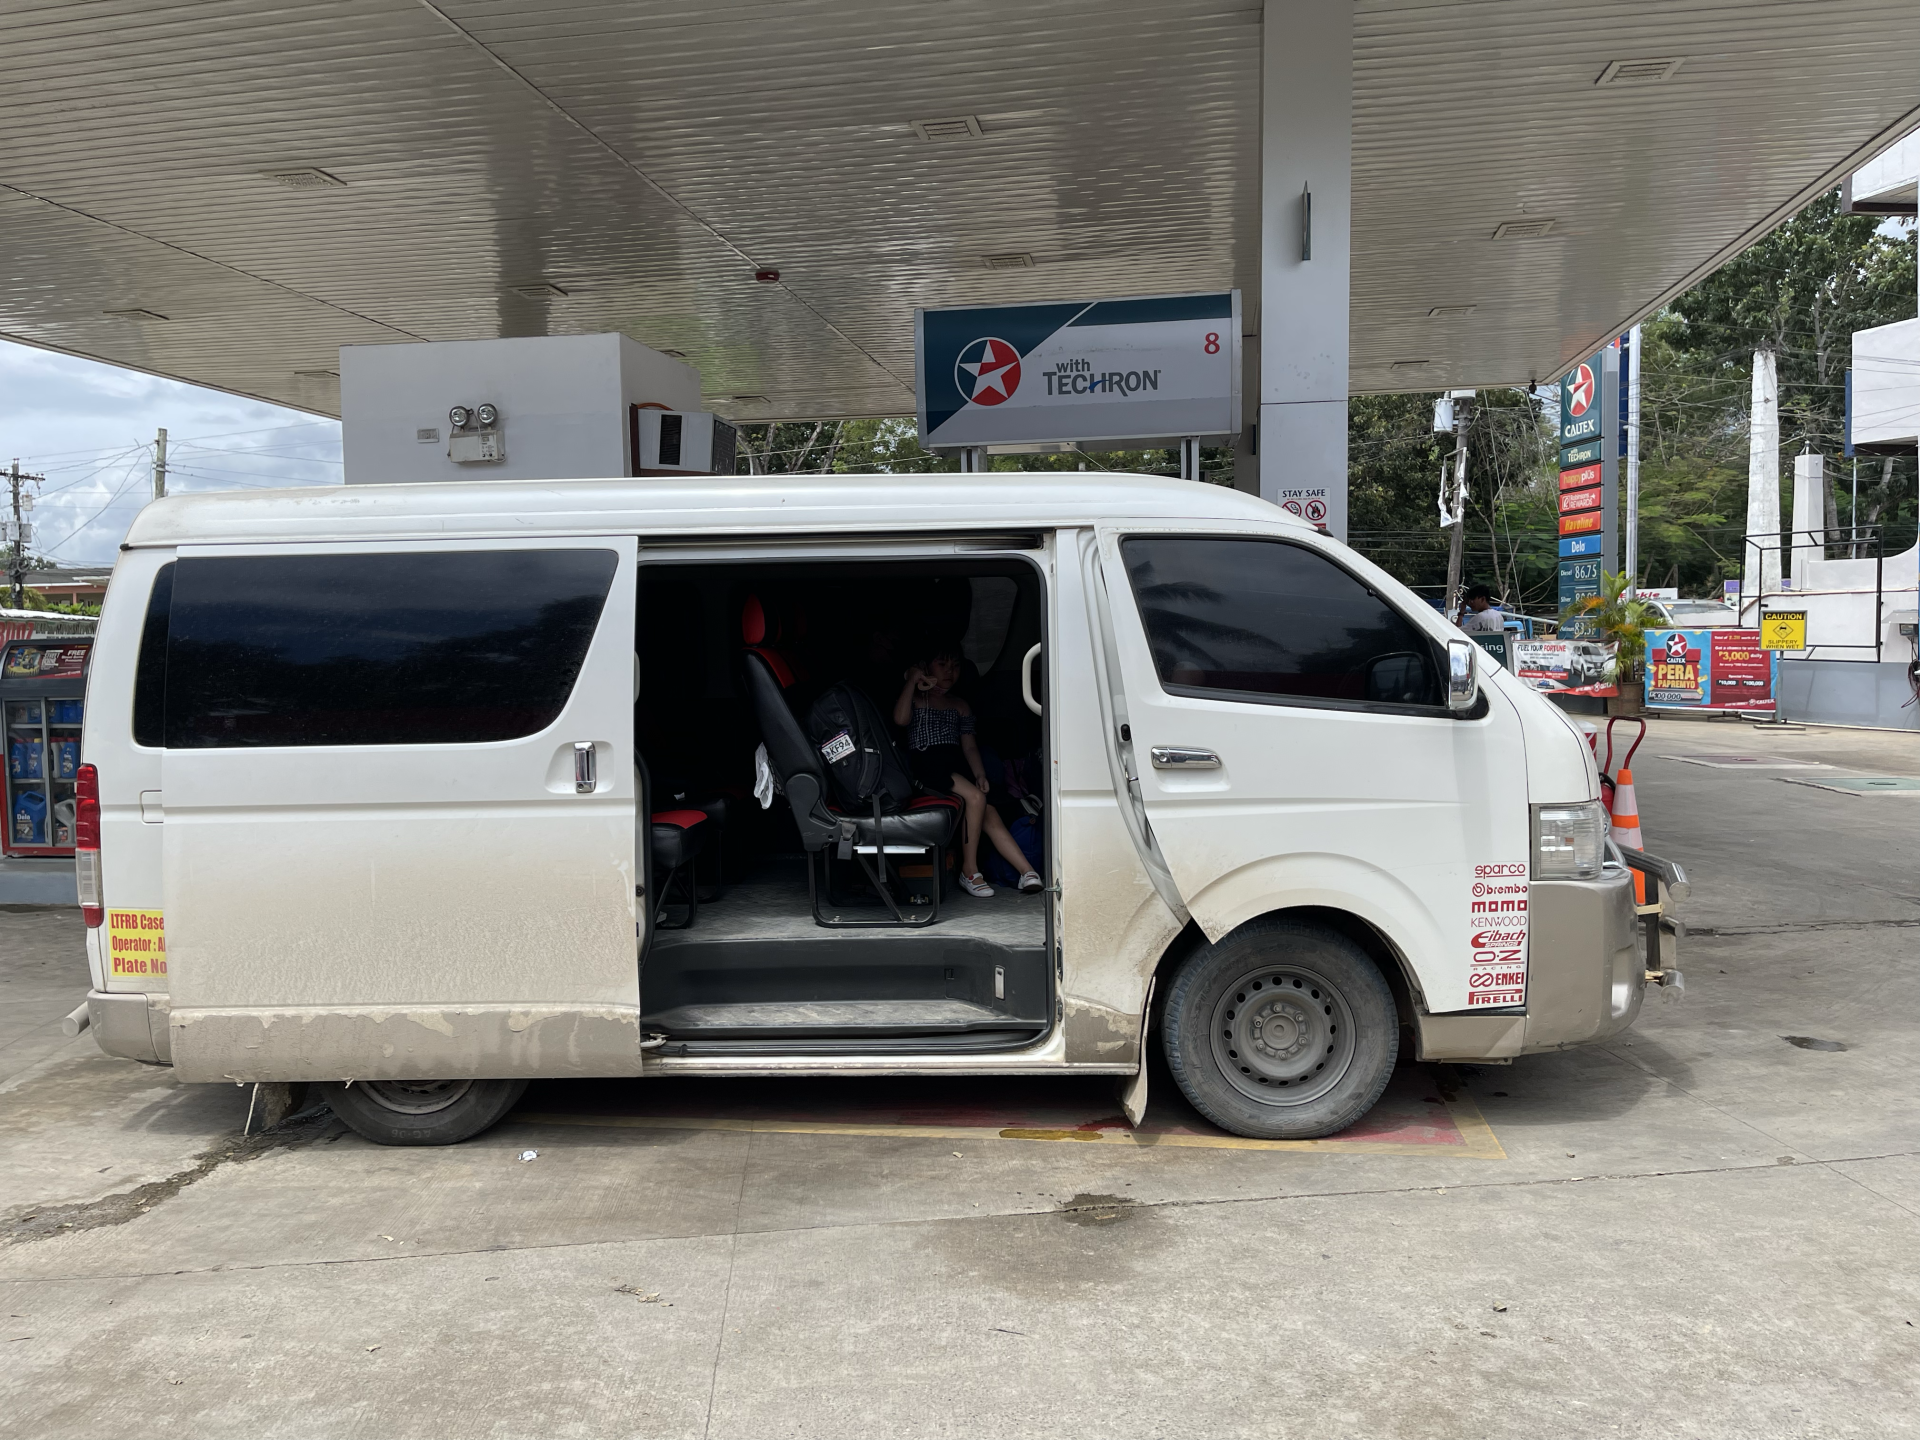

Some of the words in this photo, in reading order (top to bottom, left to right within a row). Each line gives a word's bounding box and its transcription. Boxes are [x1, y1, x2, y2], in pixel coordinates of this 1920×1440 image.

[1203, 332, 1221, 355] 8
[1055, 358, 1091, 373] with
[1042, 369, 1160, 397] TECHRON
[1564, 418, 1595, 438] CALTEX
[1567, 450, 1592, 463] TECHRON
[1282, 489, 1304, 498] STAY
[1305, 488, 1326, 497] SAFE
[1564, 517, 1593, 532] Havoline
[1571, 540, 1586, 554] Delo
[1560, 569, 1573, 577] Diesel
[1574, 564, 1597, 580] 86.75
[1560, 595, 1572, 604] Silver
[1517, 644, 1530, 652] FUEL
[1530, 644, 1543, 652] YOUR
[1543, 644, 1567, 652] FORTUNE
[1658, 664, 1694, 680] PERA
[1658, 680, 1696, 689] PAPREMYO
[830, 739, 851, 755] KF94
[1474, 863, 1526, 879] sparco
[1486, 883, 1528, 895] brembo
[110, 912, 138, 929] LTFRB
[140, 913, 165, 930] Case
[1470, 915, 1527, 928] KENWOOD
[112, 935, 152, 953] Operator
[1470, 929, 1527, 948] Eibach
[113, 957, 147, 974] Plate
[1495, 971, 1524, 986] ENKEI
[1467, 988, 1523, 1005] PIRELLI
